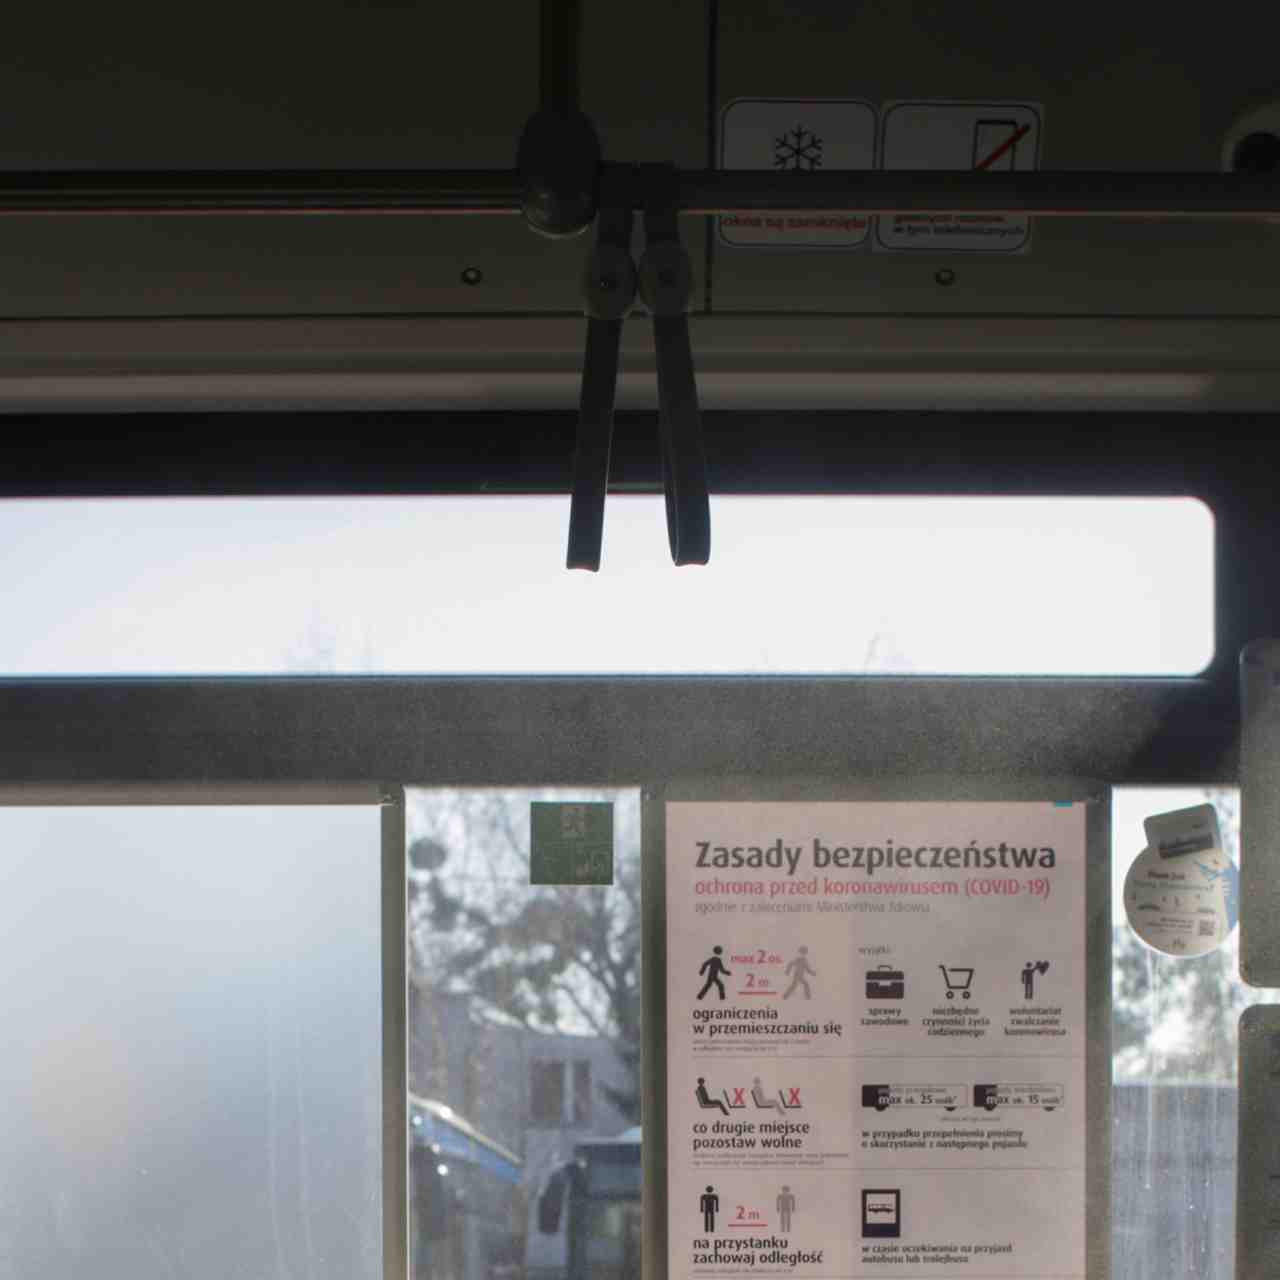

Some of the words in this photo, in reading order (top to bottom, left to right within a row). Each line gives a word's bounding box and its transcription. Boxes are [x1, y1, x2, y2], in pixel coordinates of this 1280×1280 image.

[695, 839, 801, 874] Zasady
[814, 839, 1056, 874] bezpieczeństwa
[695, 878, 763, 895] ochrona
[769, 878, 817, 899] przed
[824, 878, 958, 895] koronawirusem
[965, 877, 1050, 899] (COVID-19)
[757, 949, 768, 964] 2
[745, 973, 755, 987] 2
[692, 1005, 778, 1021] ograniczenia
[693, 1024, 705, 1034] w
[709, 1021, 819, 1036] przemieszczaniu
[823, 1021, 843, 1036] się
[693, 1124, 708, 1134] co
[712, 1120, 755, 1136] drugie
[759, 1121, 810, 1136] miejsce
[693, 1138, 756, 1150] pozostaw
[761, 1136, 803, 1149] wolne
[736, 1205, 745, 1220] 2
[748, 1211, 760, 1220] m
[693, 1239, 709, 1249] na
[713, 1236, 789, 1251] przystanku
[693, 1252, 756, 1266] zachowaj
[759, 1250, 824, 1266] odległość
